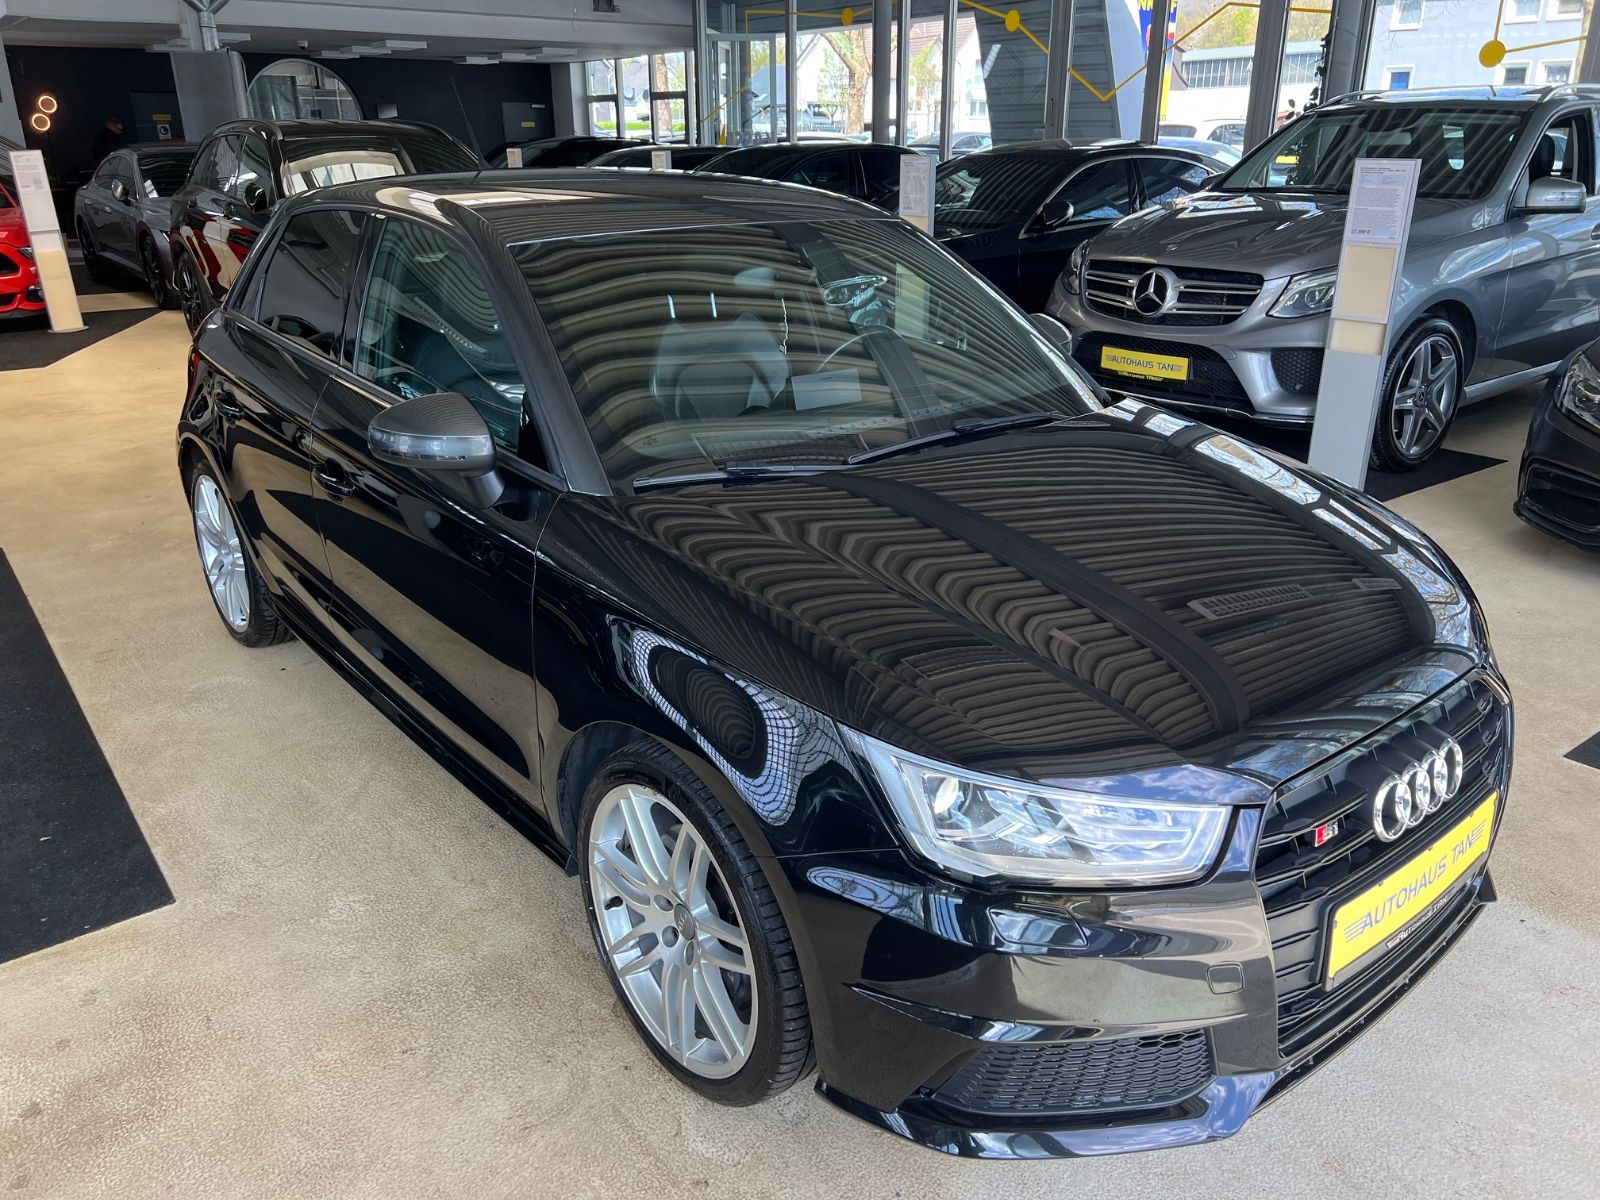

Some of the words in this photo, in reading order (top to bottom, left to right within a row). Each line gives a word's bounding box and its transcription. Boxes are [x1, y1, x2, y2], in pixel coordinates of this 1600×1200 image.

[1112, 355, 1154, 369] AUTOHAUS
[1157, 362, 1174, 372] TAN
[1362, 854, 1448, 930] AUTOHAUS
[1452, 830, 1474, 864] TAN
